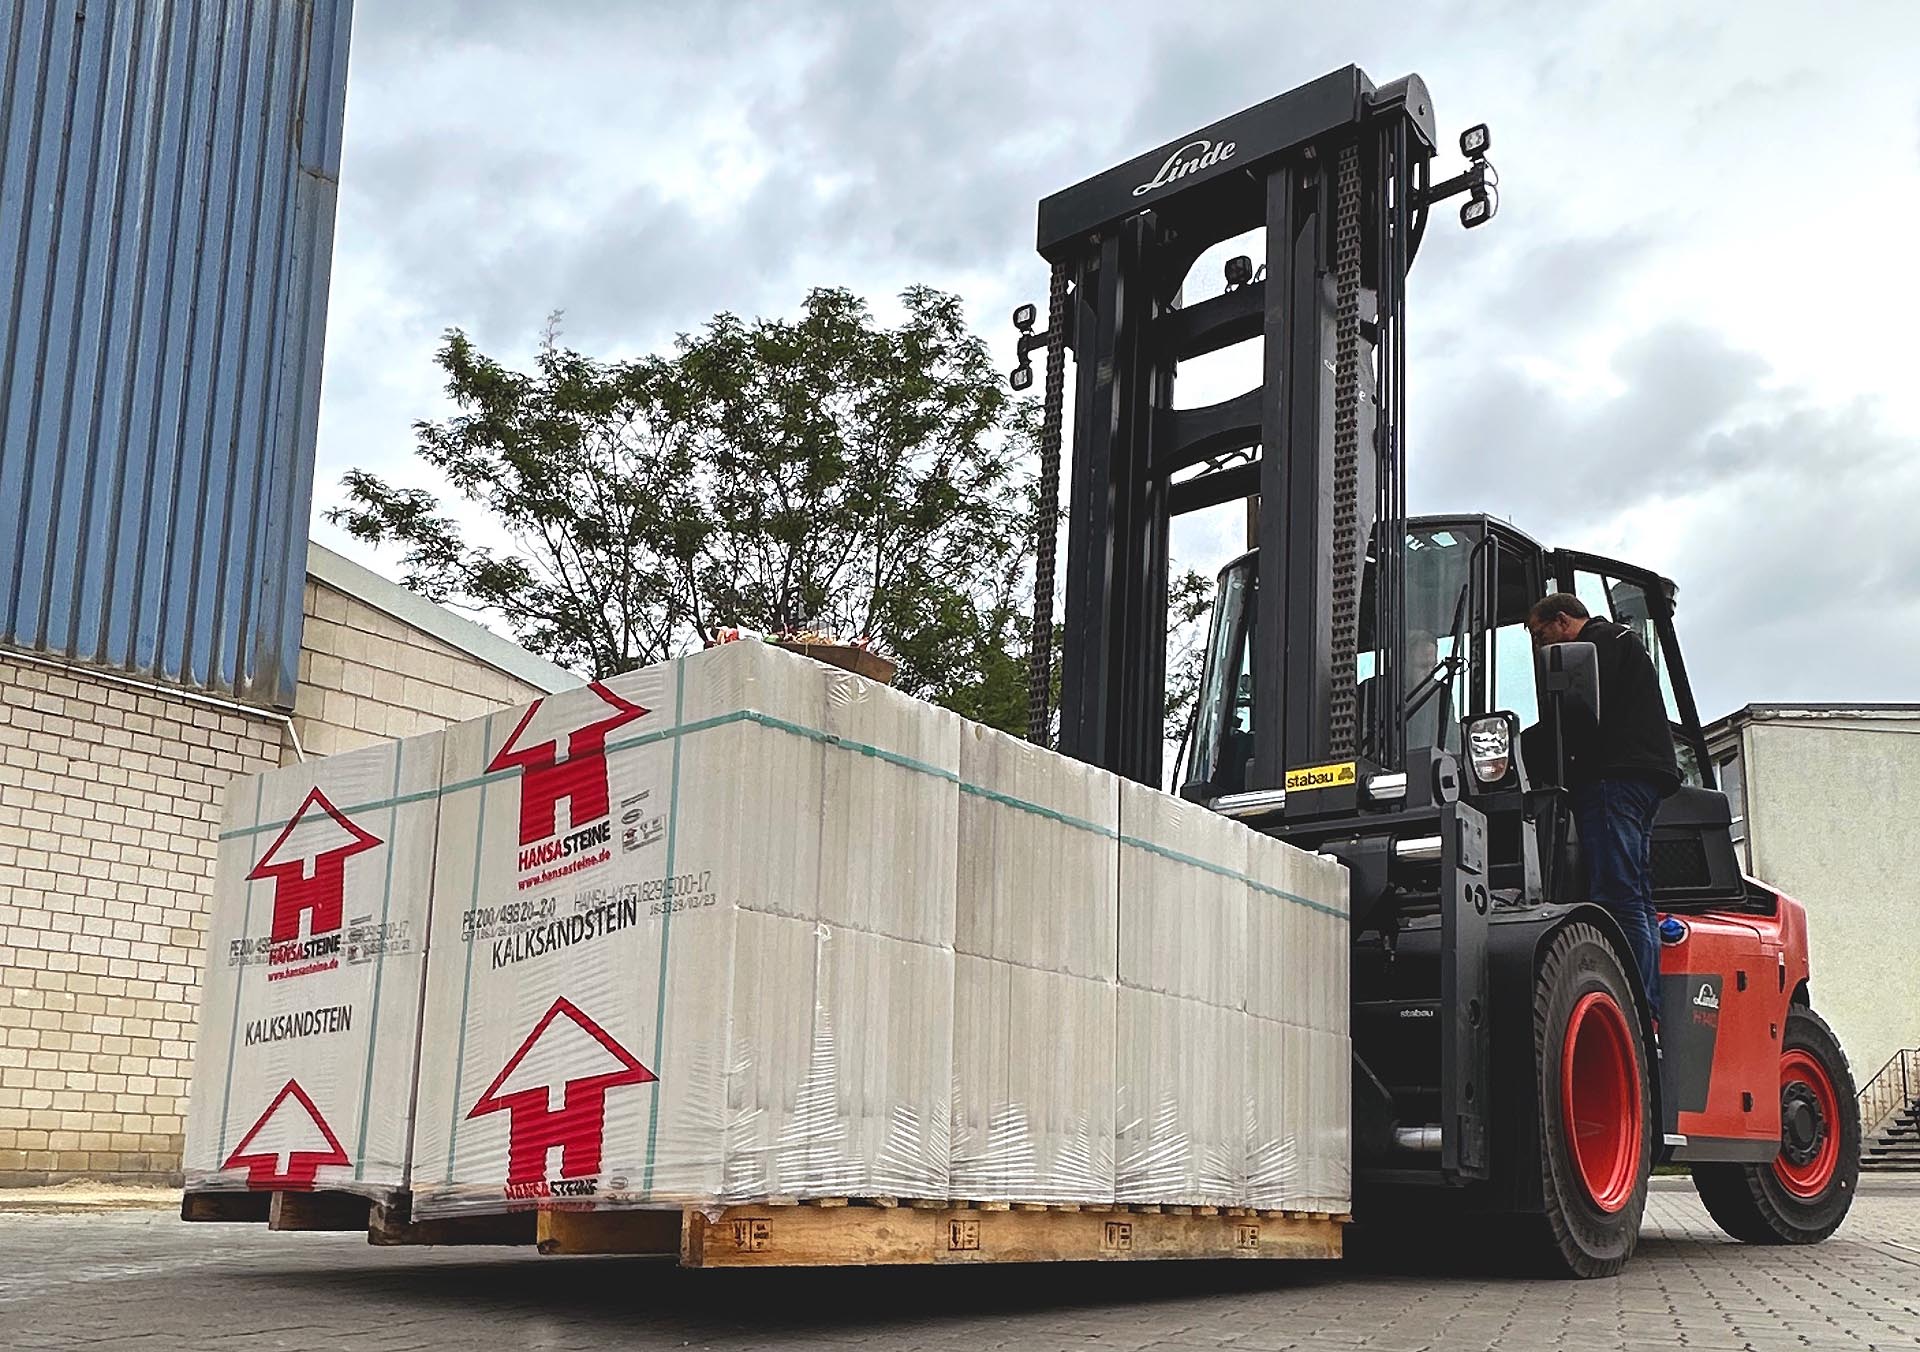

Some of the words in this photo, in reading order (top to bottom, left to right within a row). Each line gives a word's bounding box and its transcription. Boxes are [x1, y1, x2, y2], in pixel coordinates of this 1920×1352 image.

[1132, 140, 1236, 196] Linde
[1287, 772, 1334, 788] stabau
[518, 820, 611, 872] HANSASTEINE
[518, 848, 611, 890] www.hansasteine.de
[269, 934, 342, 966] HANSASTEINE
[491, 895, 637, 969] KALKSANDSTEIN
[244, 1005, 352, 1046] KALKSANDSTEIN
[1400, 1009, 1434, 1017] stabau
